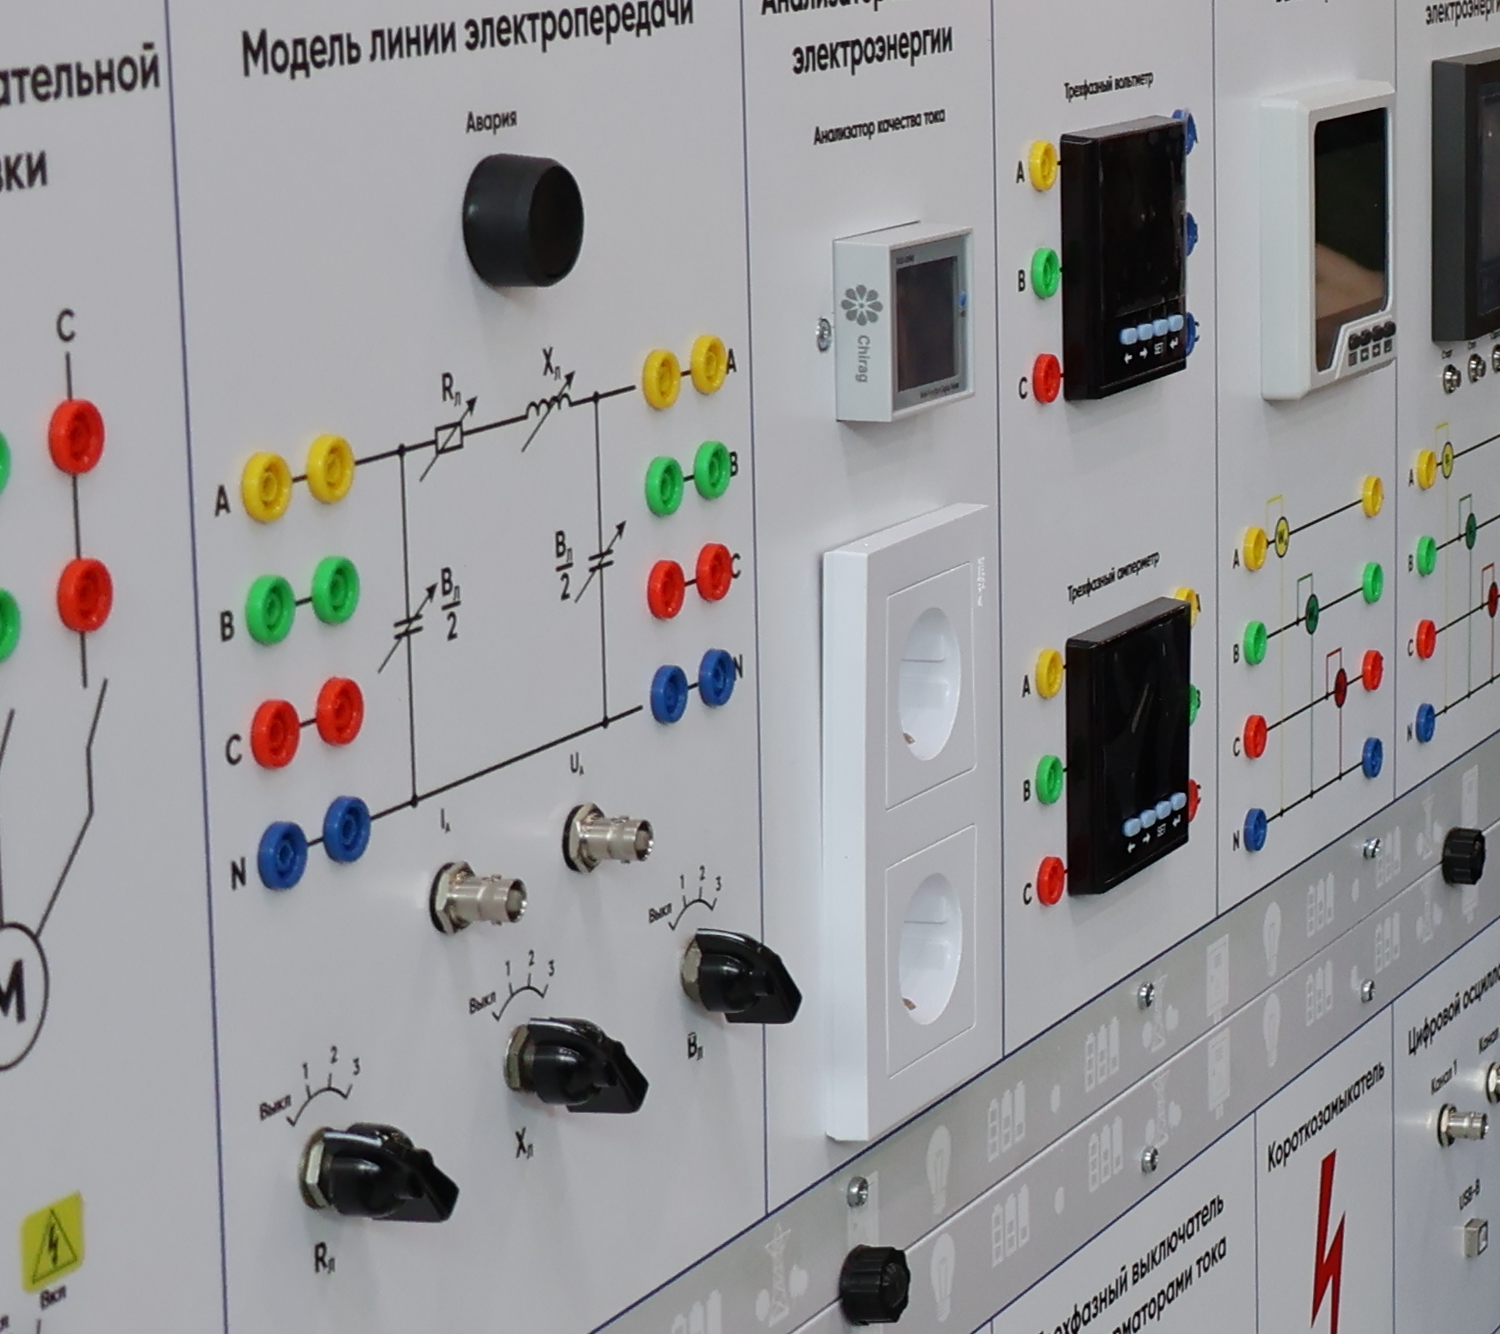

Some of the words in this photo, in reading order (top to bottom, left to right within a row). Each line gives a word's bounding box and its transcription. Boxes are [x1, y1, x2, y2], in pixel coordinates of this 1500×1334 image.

[241, 25, 362, 80] Модель
[369, 21, 457, 62] линии
[792, 25, 953, 76] электроэнергии
[1063, 74, 1113, 103] Трехфазный
[466, 108, 518, 134] Авария
[813, 122, 875, 146] Анализатор
[877, 113, 922, 136] качества
[924, 108, 946, 126] тока
[1015, 161, 1026, 184] A
[1018, 270, 1026, 293] B
[56, 308, 76, 343] C
[855, 334, 872, 384] Chirag
[1018, 376, 1028, 400] C
[214, 485, 230, 517] A
[1233, 548, 1240, 569] A
[560, 572, 571, 602] 2
[1067, 566, 1116, 604] Трехфазный
[221, 611, 235, 643] B
[446, 611, 459, 642] 2
[1233, 643, 1240, 664] B
[1022, 675, 1032, 698] A
[225, 733, 243, 766] C
[1233, 737, 1241, 758] C
[1023, 780, 1032, 802] B
[1233, 830, 1240, 852] N
[231, 857, 247, 891] N
[714, 876, 722, 893] 3
[1023, 882, 1032, 905] C
[648, 902, 673, 929] Выкл
[527, 950, 535, 967] 2
[547, 960, 555, 977] 3
[469, 989, 498, 1017] Выкл
[1408, 991, 1461, 1056] Цифровой
[1478, 1028, 1499, 1054] Канал
[329, 1046, 339, 1064] 2
[352, 1057, 361, 1077] 3
[1430, 1066, 1452, 1096] Канал
[260, 1092, 292, 1123] Выкл
[1267, 1060, 1385, 1172] Короткозамыкатель
[1459, 1178, 1481, 1212] USB-B
[1131, 1193, 1225, 1293] выключатель
[1197, 1235, 1228, 1279] тока
[39, 1283, 67, 1310] Вкл
